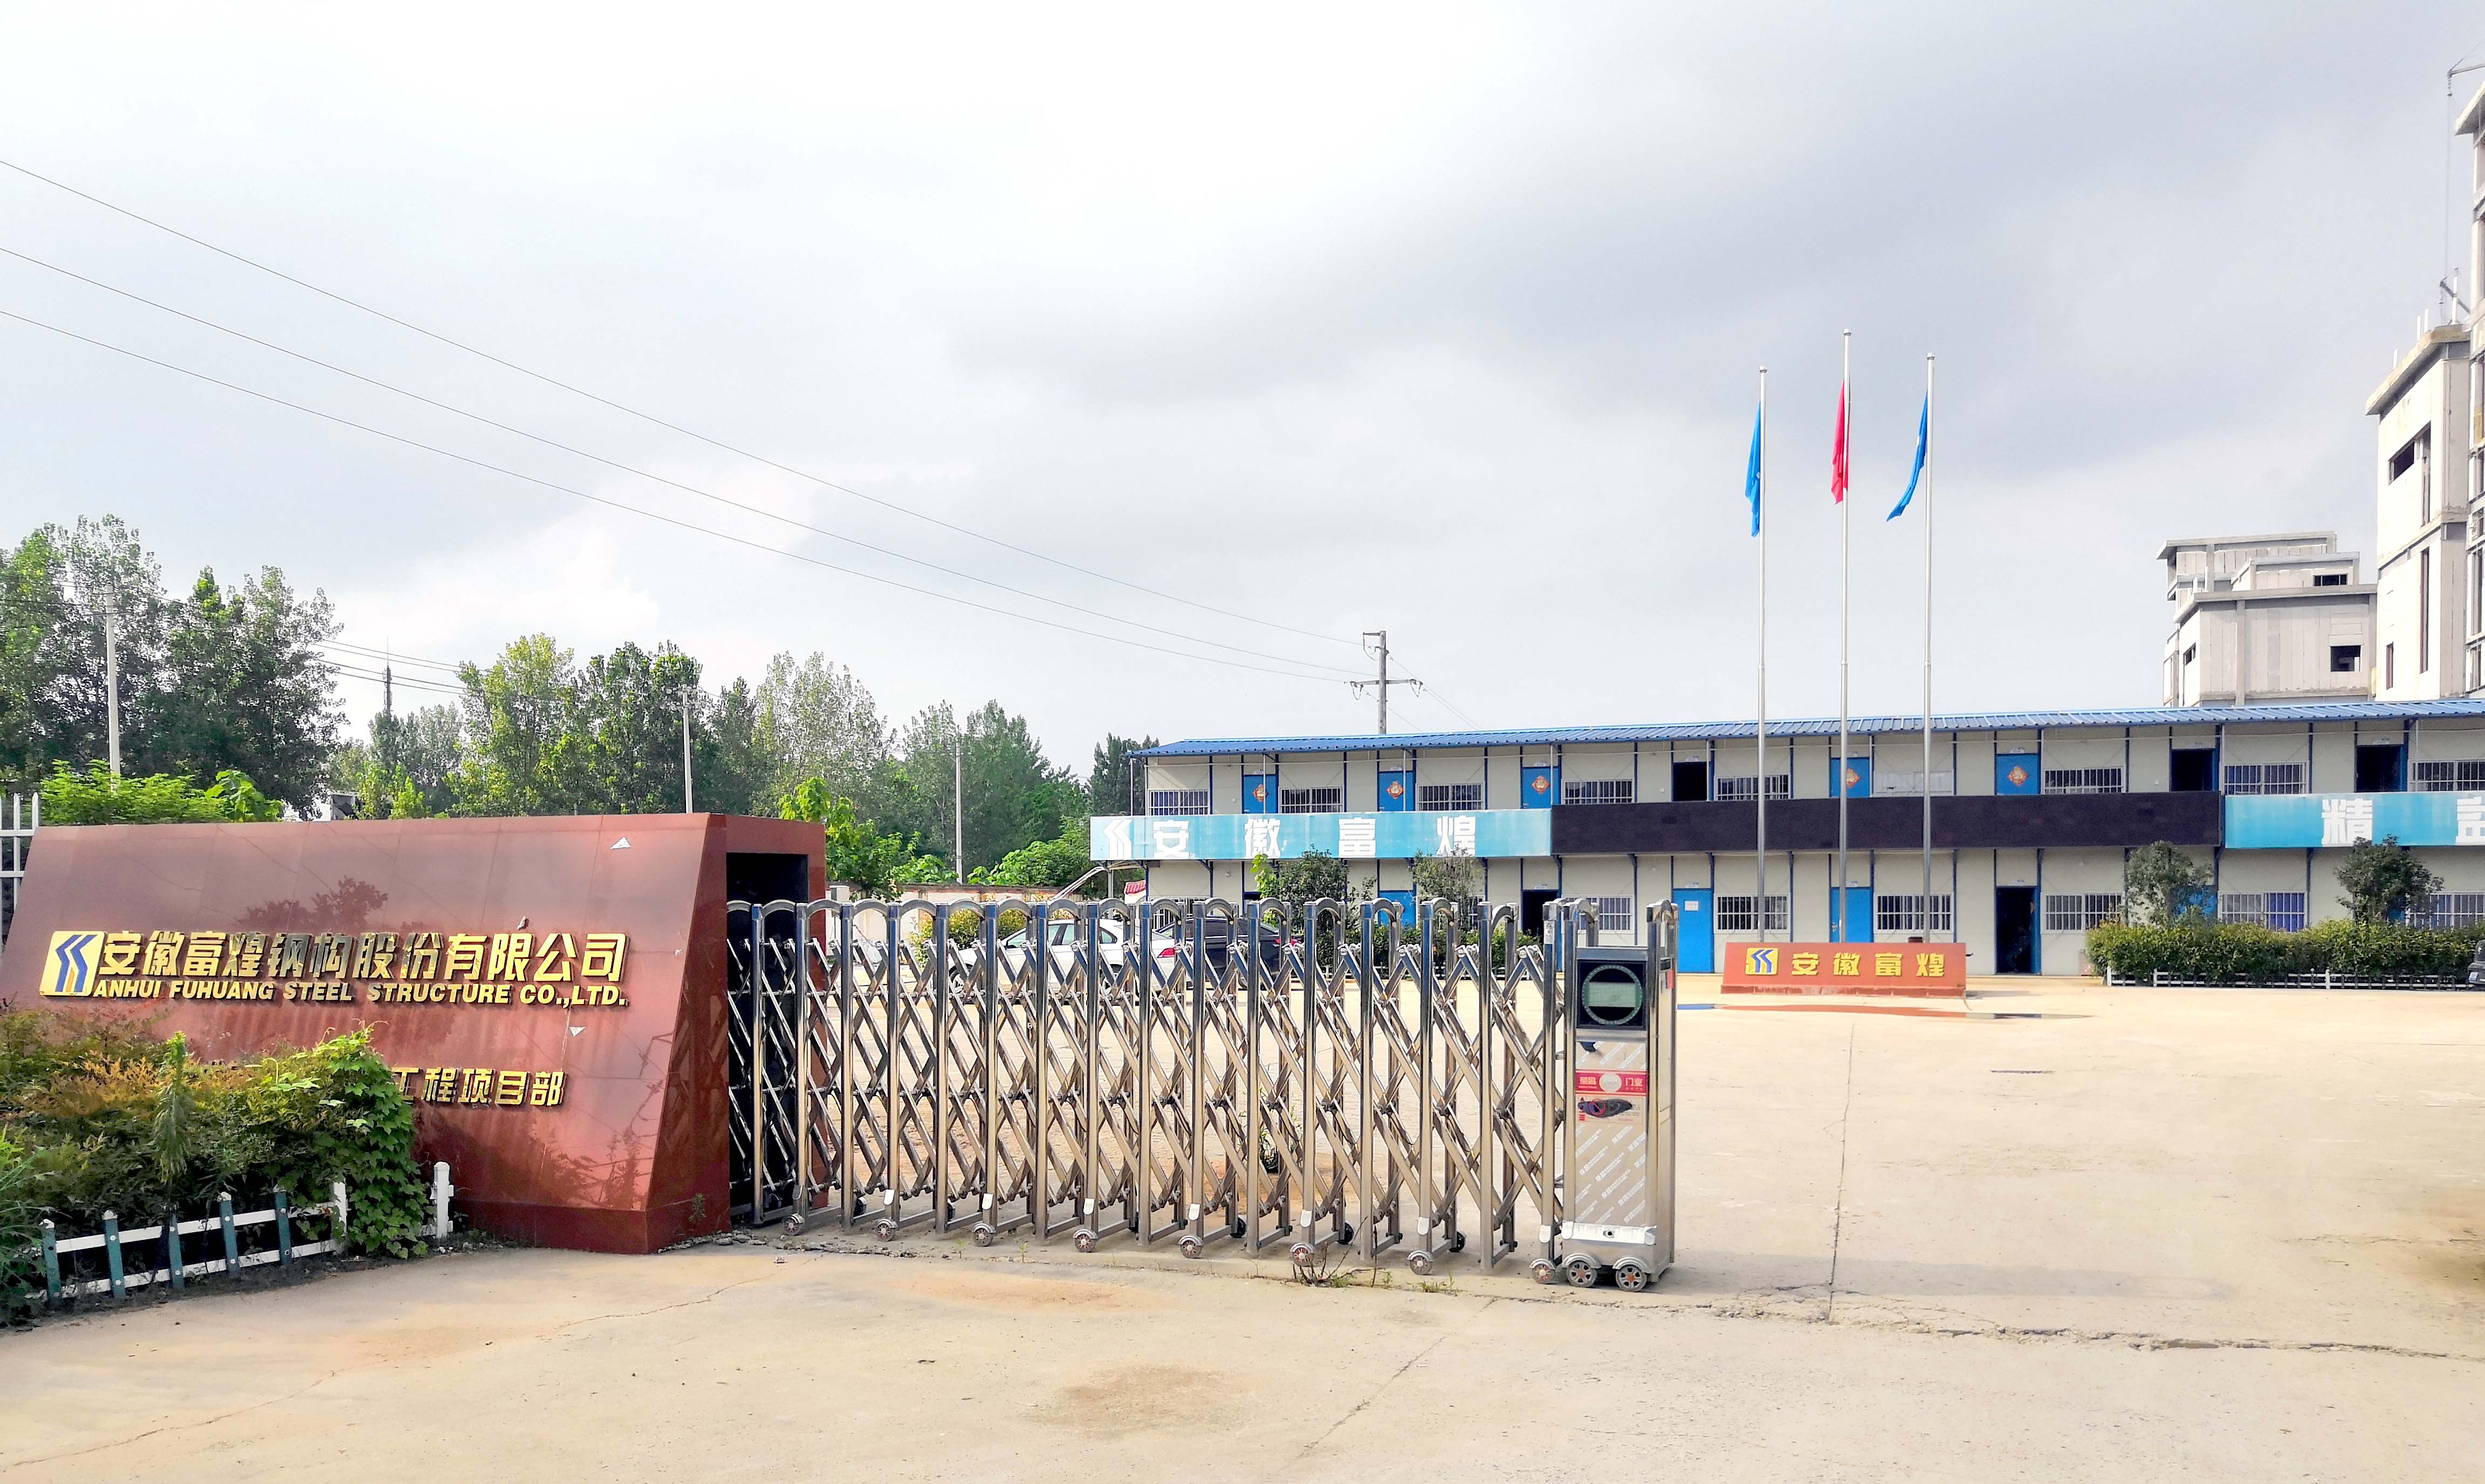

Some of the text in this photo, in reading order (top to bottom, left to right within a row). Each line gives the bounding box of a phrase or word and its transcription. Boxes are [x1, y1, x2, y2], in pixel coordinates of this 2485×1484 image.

[1153, 816, 1475, 858] 安徽富煌
[99, 930, 627, 982] 安徽富煌钢构股份有限公司
[1791, 952, 1945, 977] 安徽富煌
[93, 979, 162, 998] ANHUI
[169, 980, 274, 1000] FUHUANG
[283, 982, 352, 1001] STEEL
[367, 983, 512, 1004] STRUCTURE
[1625, 1077, 1643, 1087] 门业
